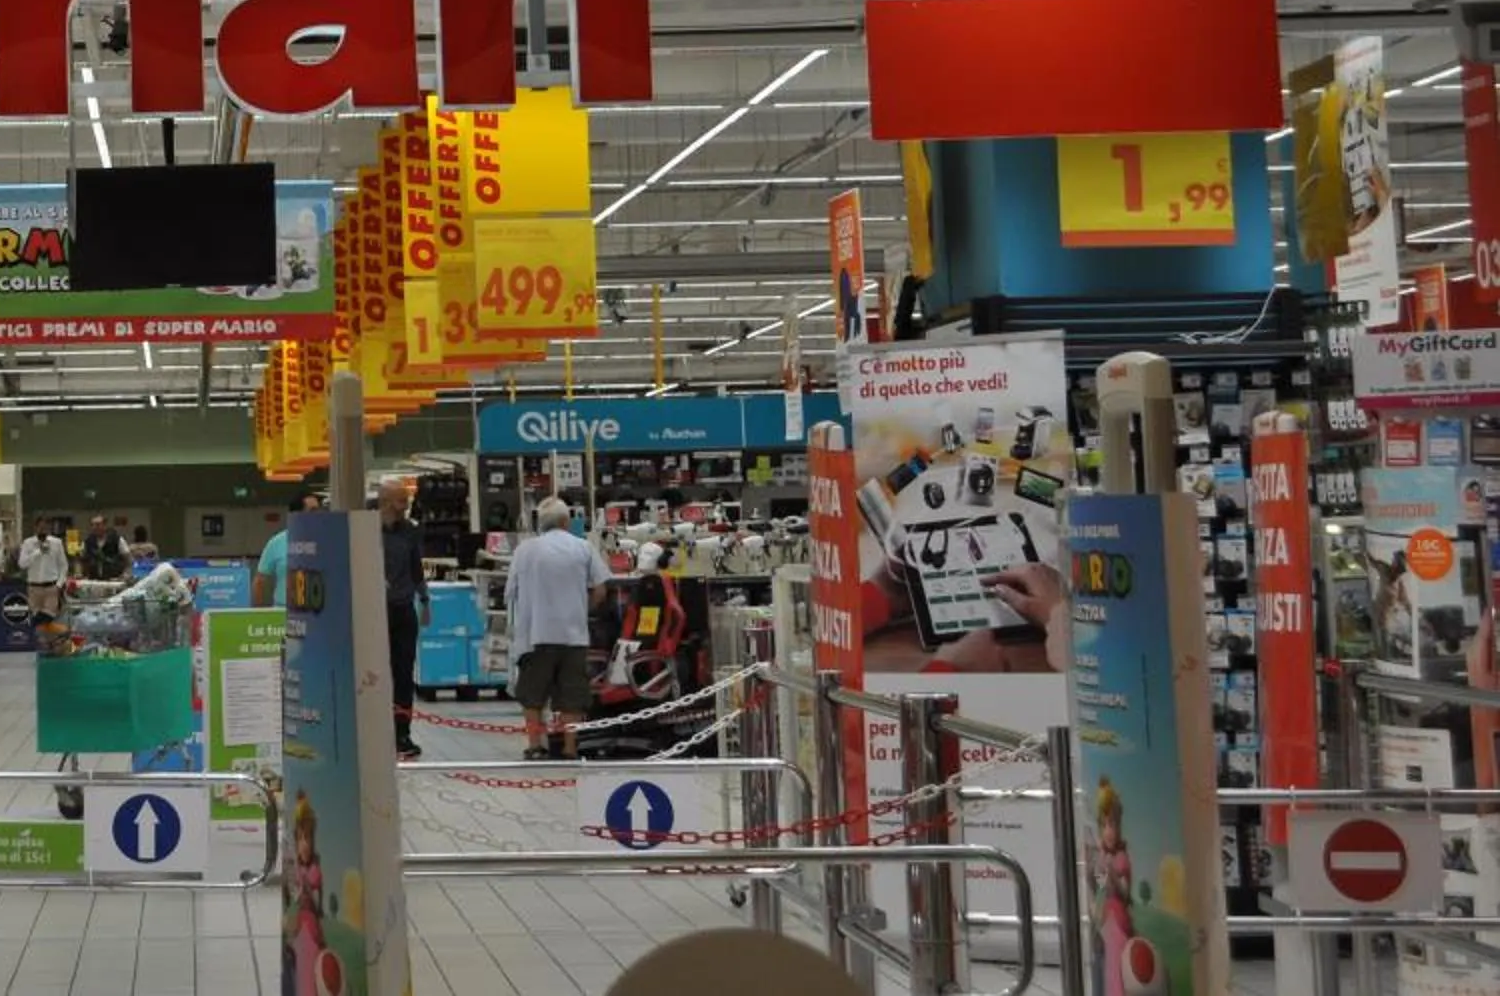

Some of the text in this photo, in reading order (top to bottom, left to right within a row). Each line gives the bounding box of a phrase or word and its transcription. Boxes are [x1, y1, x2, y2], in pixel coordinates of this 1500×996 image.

[473, 110, 501, 205] OFFE
[406, 113, 439, 271] OFFERT
[42, 321, 105, 337] PREMI
[115, 321, 134, 336] DI
[143, 320, 207, 335] SUPER
[210, 319, 277, 334] MARIO
[1378, 332, 1497, 358] MyGiftCard
[885, 356, 937, 373] molto
[939, 350, 966, 374] più
[859, 371, 1009, 401] di quello che vedi!
[516, 409, 621, 444] Qilive
[662, 427, 706, 440] Auchan
[268, 625, 286, 637] tu
[251, 642, 281, 653] men
[868, 722, 897, 738] per
[869, 745, 887, 761] la
